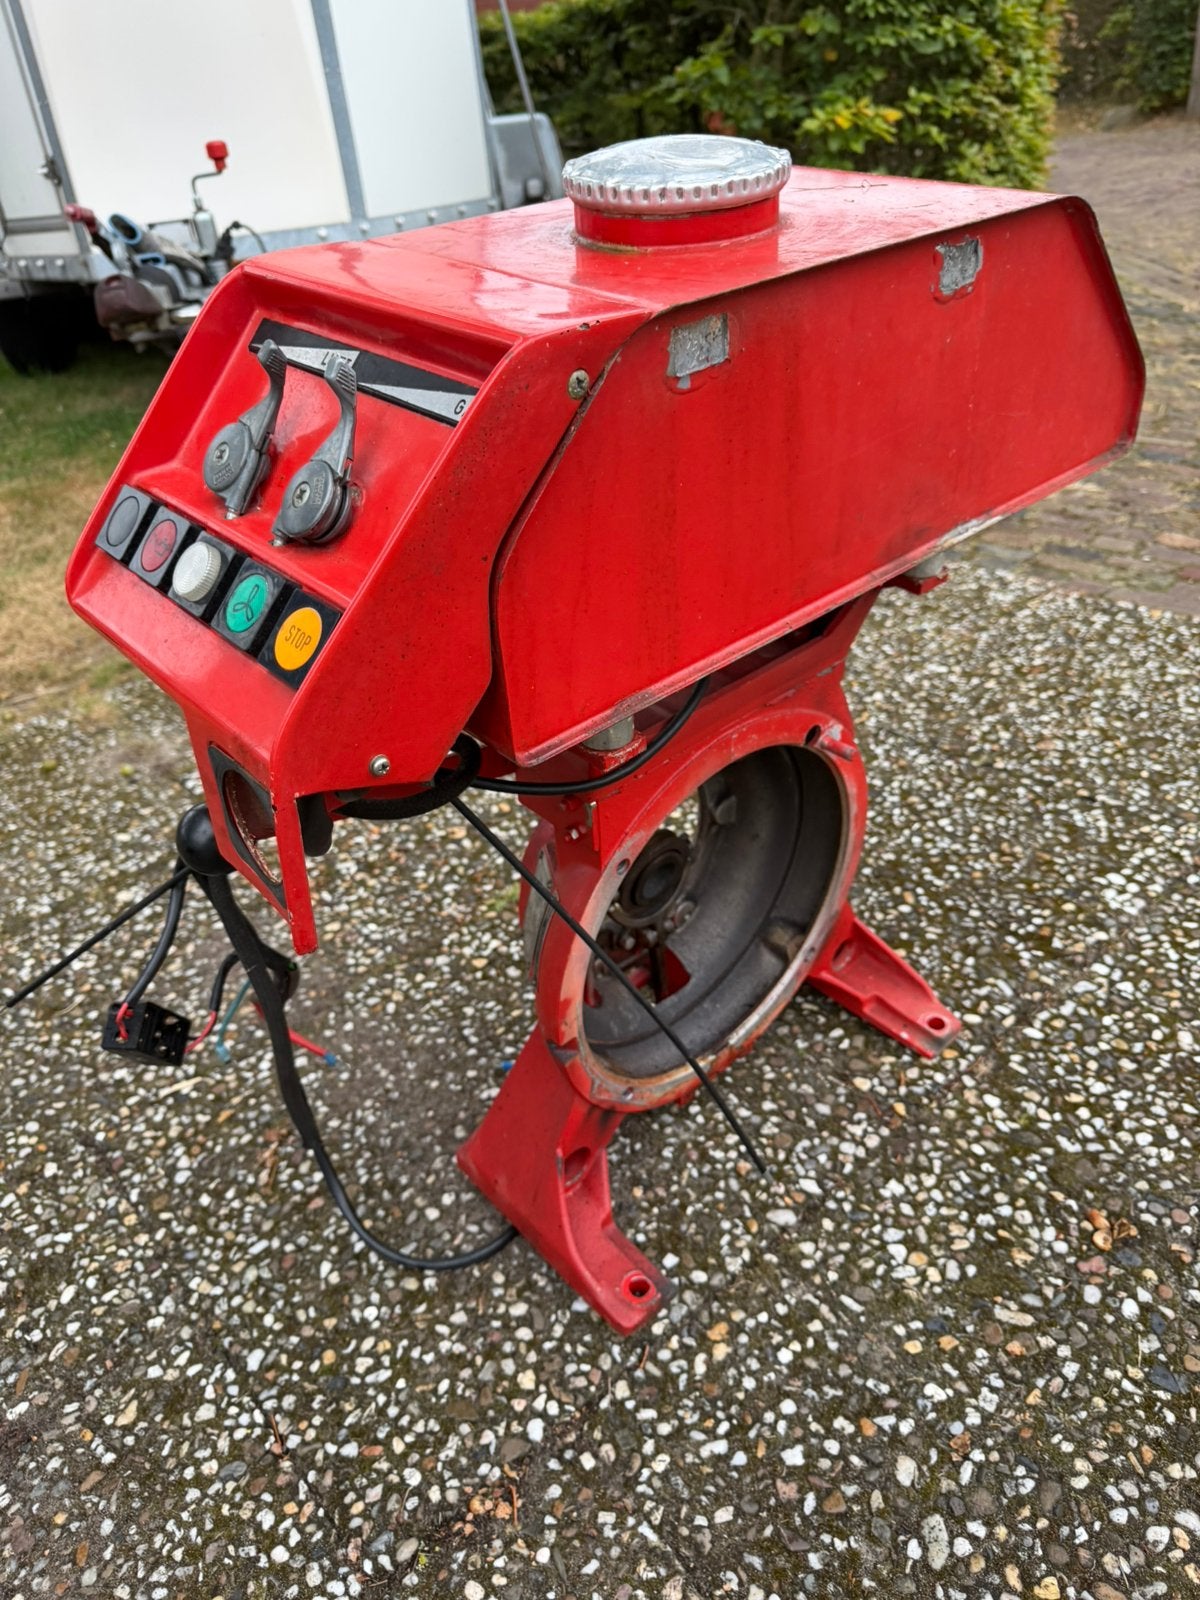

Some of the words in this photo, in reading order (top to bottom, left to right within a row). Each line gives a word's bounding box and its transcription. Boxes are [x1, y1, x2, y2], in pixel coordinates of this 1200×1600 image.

[320, 351, 352, 365] LT
[453, 398, 467, 416] G
[284, 624, 312, 651] STOP
